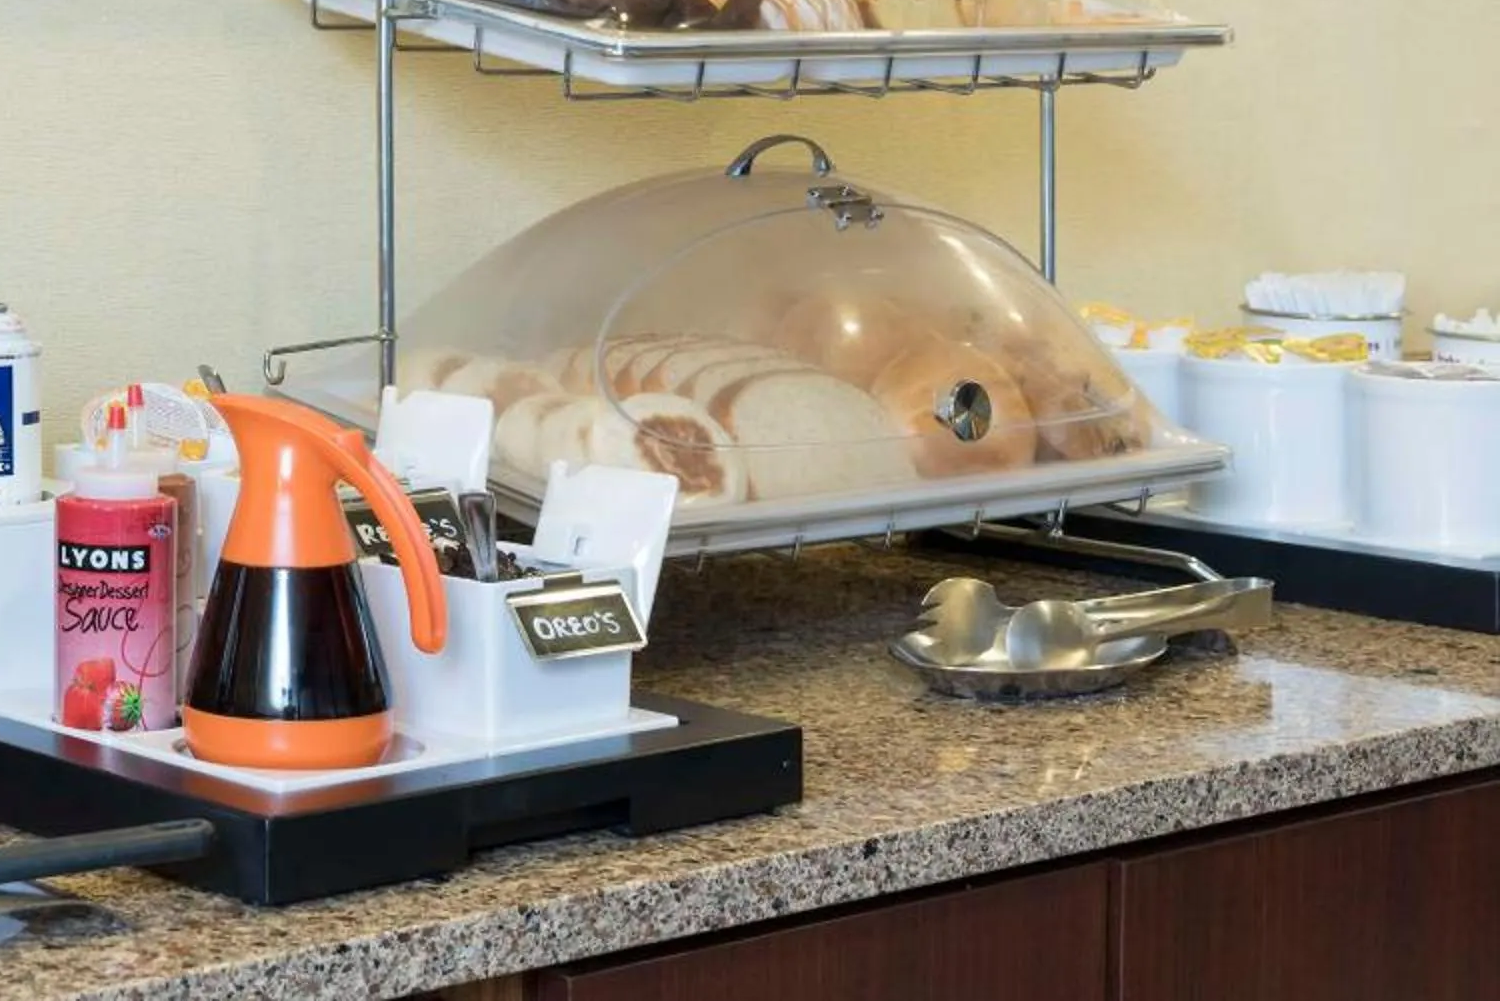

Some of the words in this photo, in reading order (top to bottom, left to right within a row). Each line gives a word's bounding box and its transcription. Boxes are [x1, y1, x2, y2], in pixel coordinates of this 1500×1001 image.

[61, 544, 146, 570] LYONS
[99, 580, 149, 600] Dessert
[62, 596, 139, 633] Sauce
[533, 611, 621, 640] OREO'S
